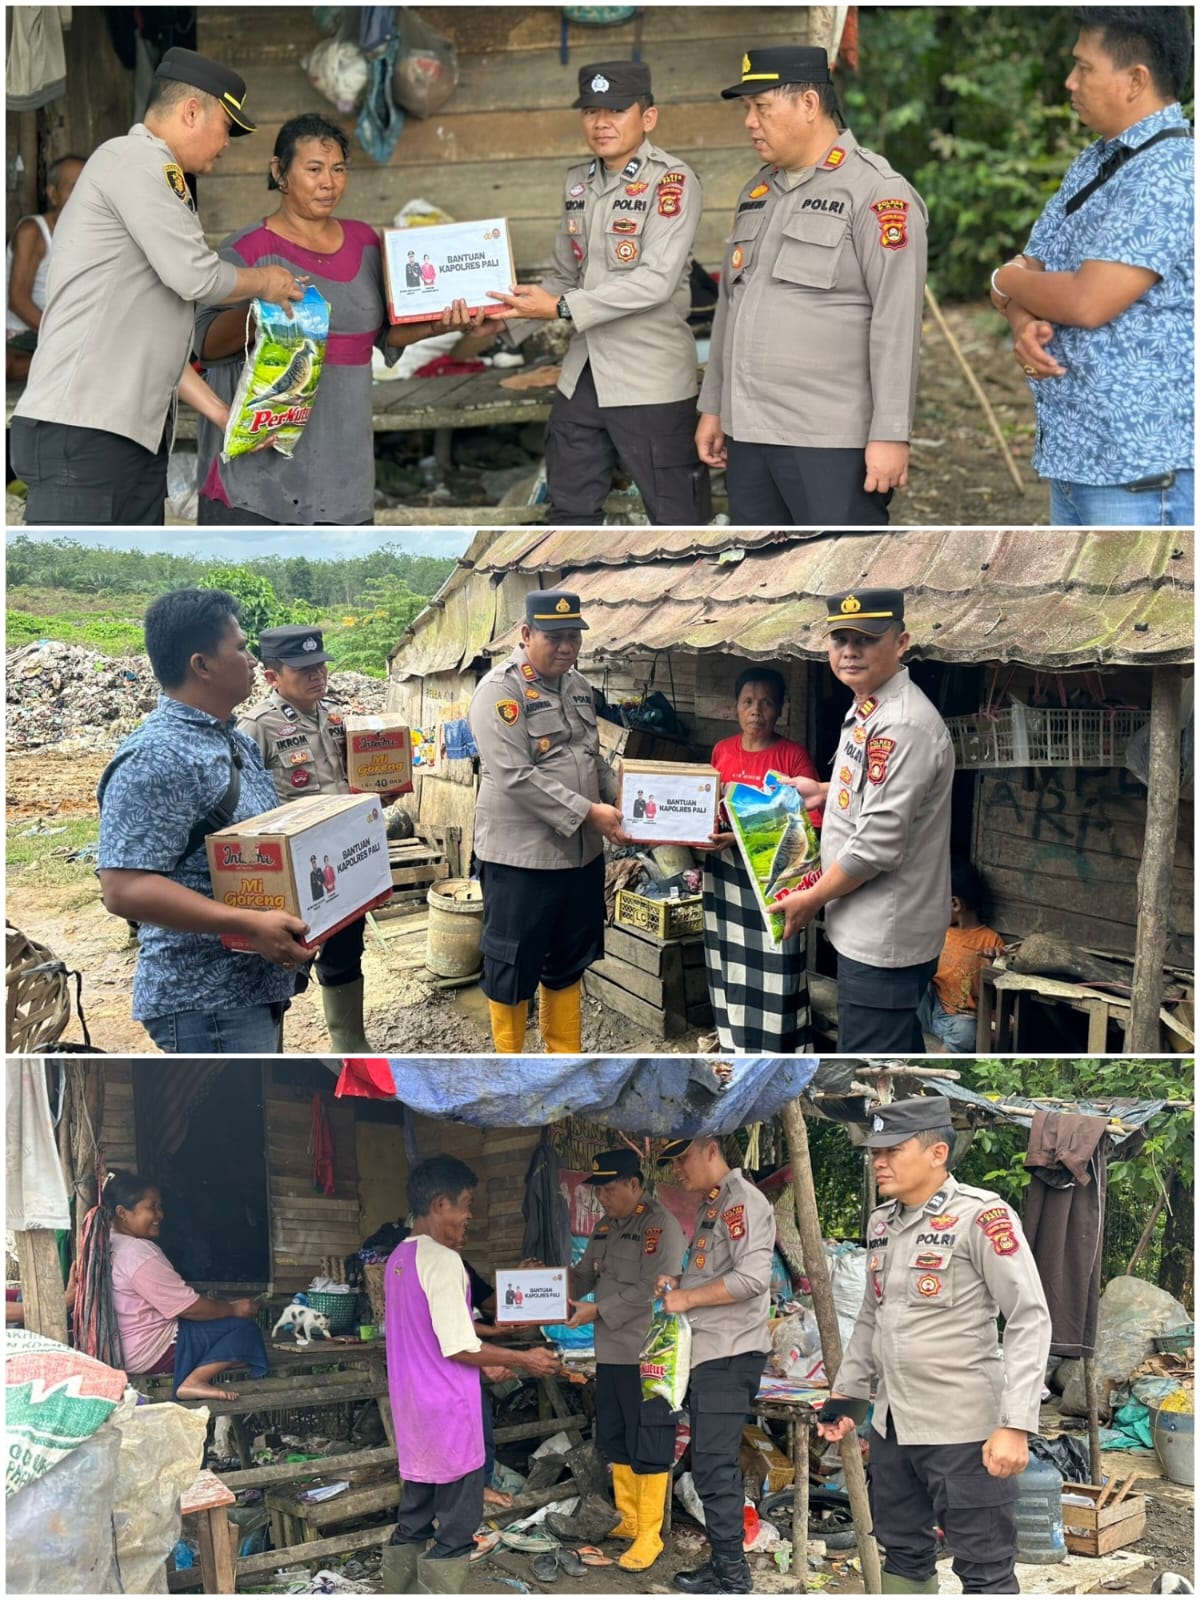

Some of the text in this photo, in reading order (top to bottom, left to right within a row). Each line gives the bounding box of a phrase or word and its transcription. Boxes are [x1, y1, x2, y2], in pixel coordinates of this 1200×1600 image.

[612, 200, 646, 211] POLRI
[801, 199, 845, 214] POLRI
[447, 251, 486, 263] BANTUAN
[439, 259, 499, 273] KAPOLRES PALI
[276, 735, 309, 750] IKROM
[357, 762, 405, 777] Goreng
[375, 779, 388, 787] 40
[659, 805, 692, 813] KAPOLRES
[342, 837, 371, 859] BANTUAN
[336, 842, 380, 873] KAPOLRES PALI
[241, 878, 264, 894] Mi
[224, 891, 285, 911] Goreng
[915, 1234, 956, 1245] POLRI
